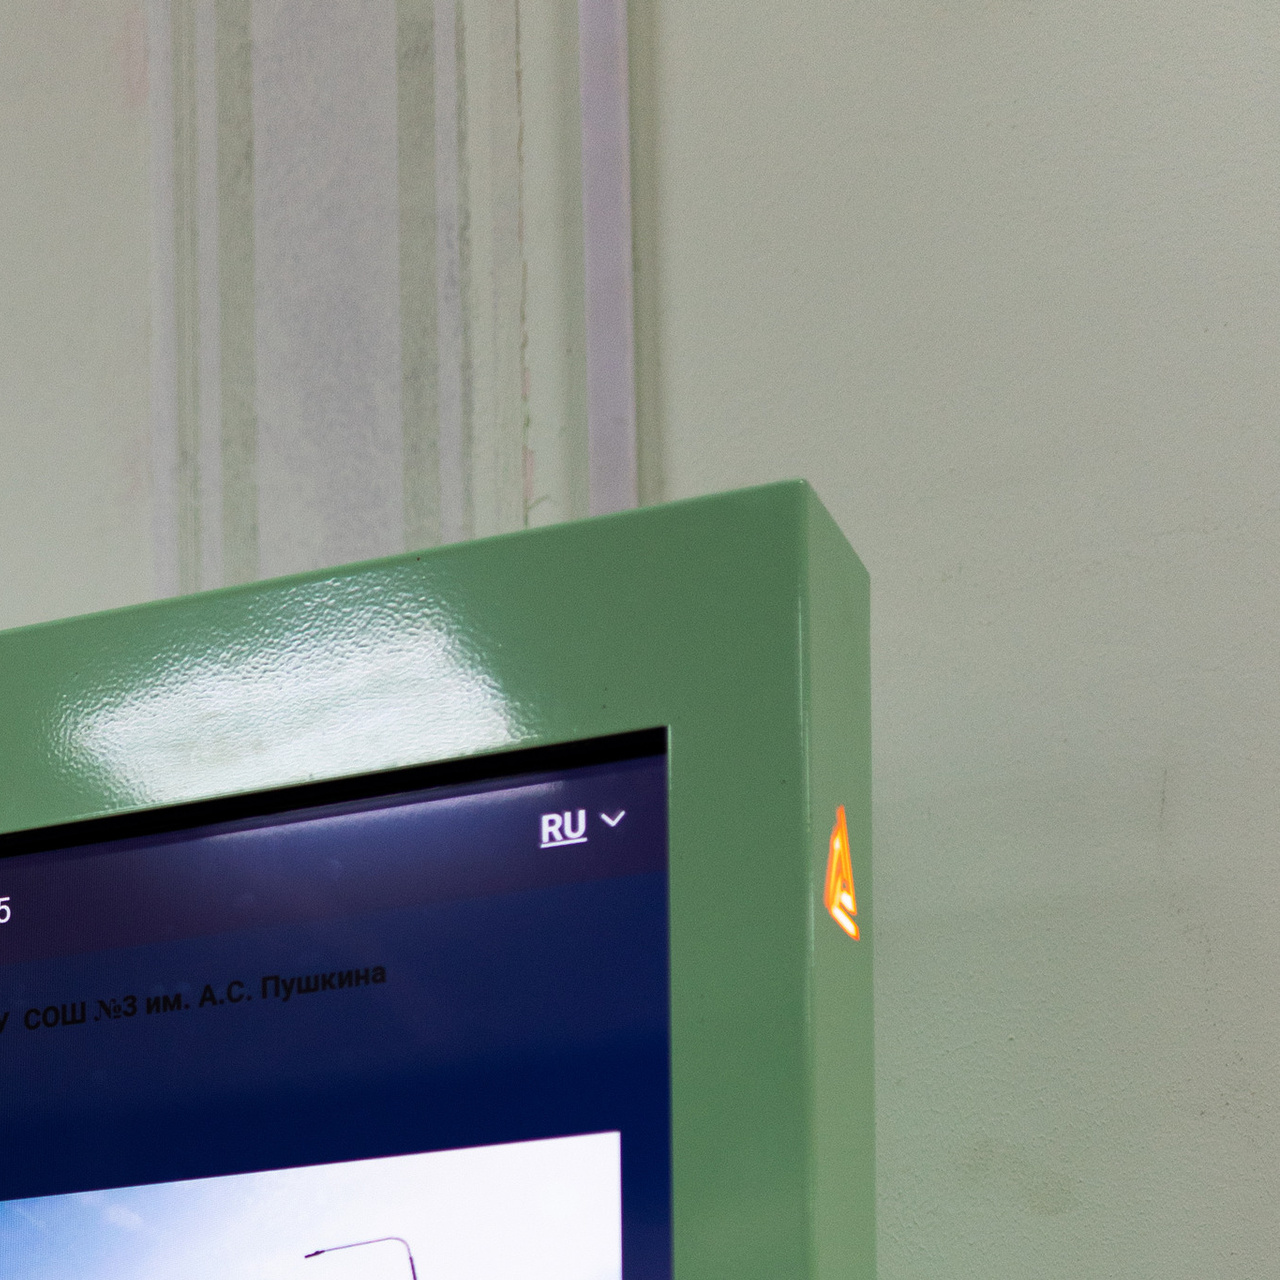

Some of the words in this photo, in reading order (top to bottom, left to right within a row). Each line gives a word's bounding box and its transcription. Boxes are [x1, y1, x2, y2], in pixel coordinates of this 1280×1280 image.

[540, 809, 588, 847] RU
[23, 1002, 86, 1031] СОШ
[93, 994, 139, 1023] №3
[145, 993, 191, 1017] им.
[197, 979, 253, 1008] А.С.
[261, 964, 388, 1002] Пушкина
